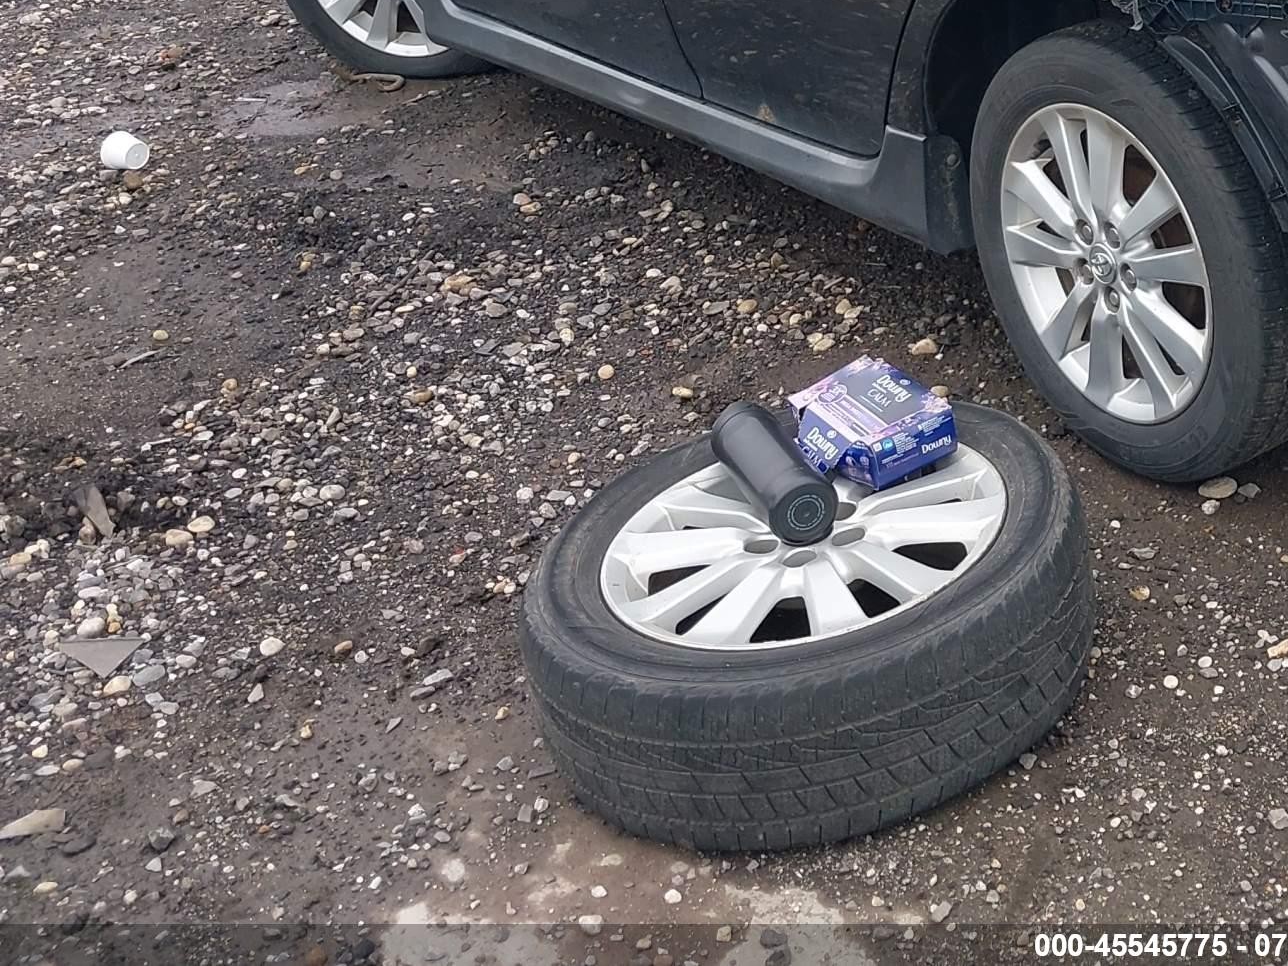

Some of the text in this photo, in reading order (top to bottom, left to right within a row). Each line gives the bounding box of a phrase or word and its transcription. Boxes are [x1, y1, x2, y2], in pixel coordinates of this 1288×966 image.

[867, 388, 892, 407] CALM
[876, 374, 912, 402] Downy
[807, 427, 839, 460] Downy
[921, 435, 953, 454] Downy
